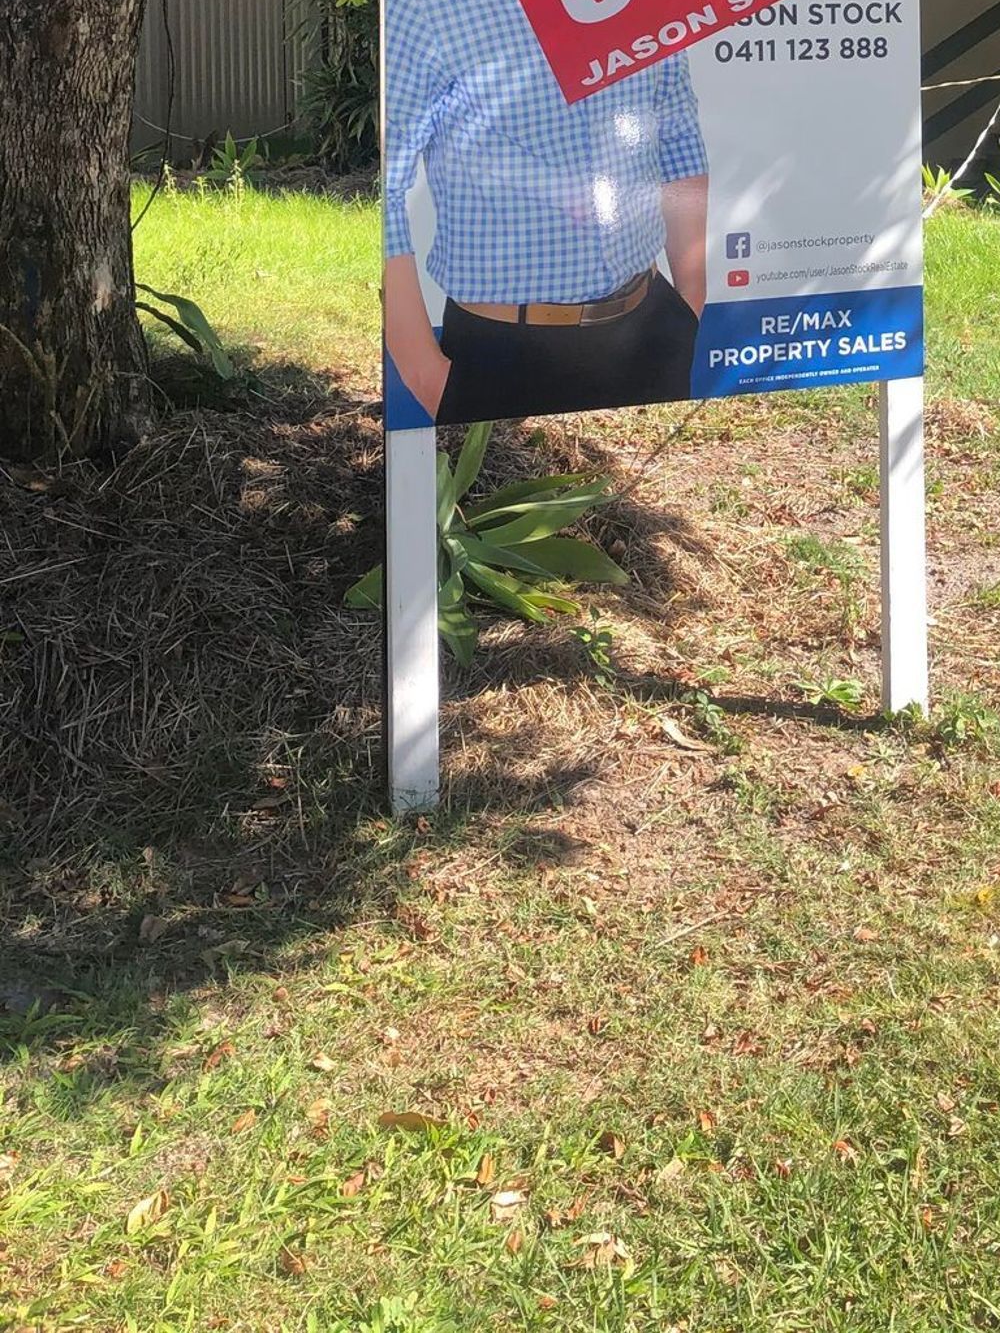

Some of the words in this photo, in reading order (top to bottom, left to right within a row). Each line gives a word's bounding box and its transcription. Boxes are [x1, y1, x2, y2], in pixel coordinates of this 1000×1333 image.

[808, 2, 902, 25] STOCK
[581, 4, 718, 86] JASON
[714, 39, 776, 63] 0411
[786, 38, 830, 61] 123
[839, 36, 888, 59] 888
[757, 233, 876, 253] @jasonstockproperty
[761, 309, 852, 336] RE/MAX
[709, 339, 832, 368] PROPERTY
[838, 331, 907, 355] SALES
